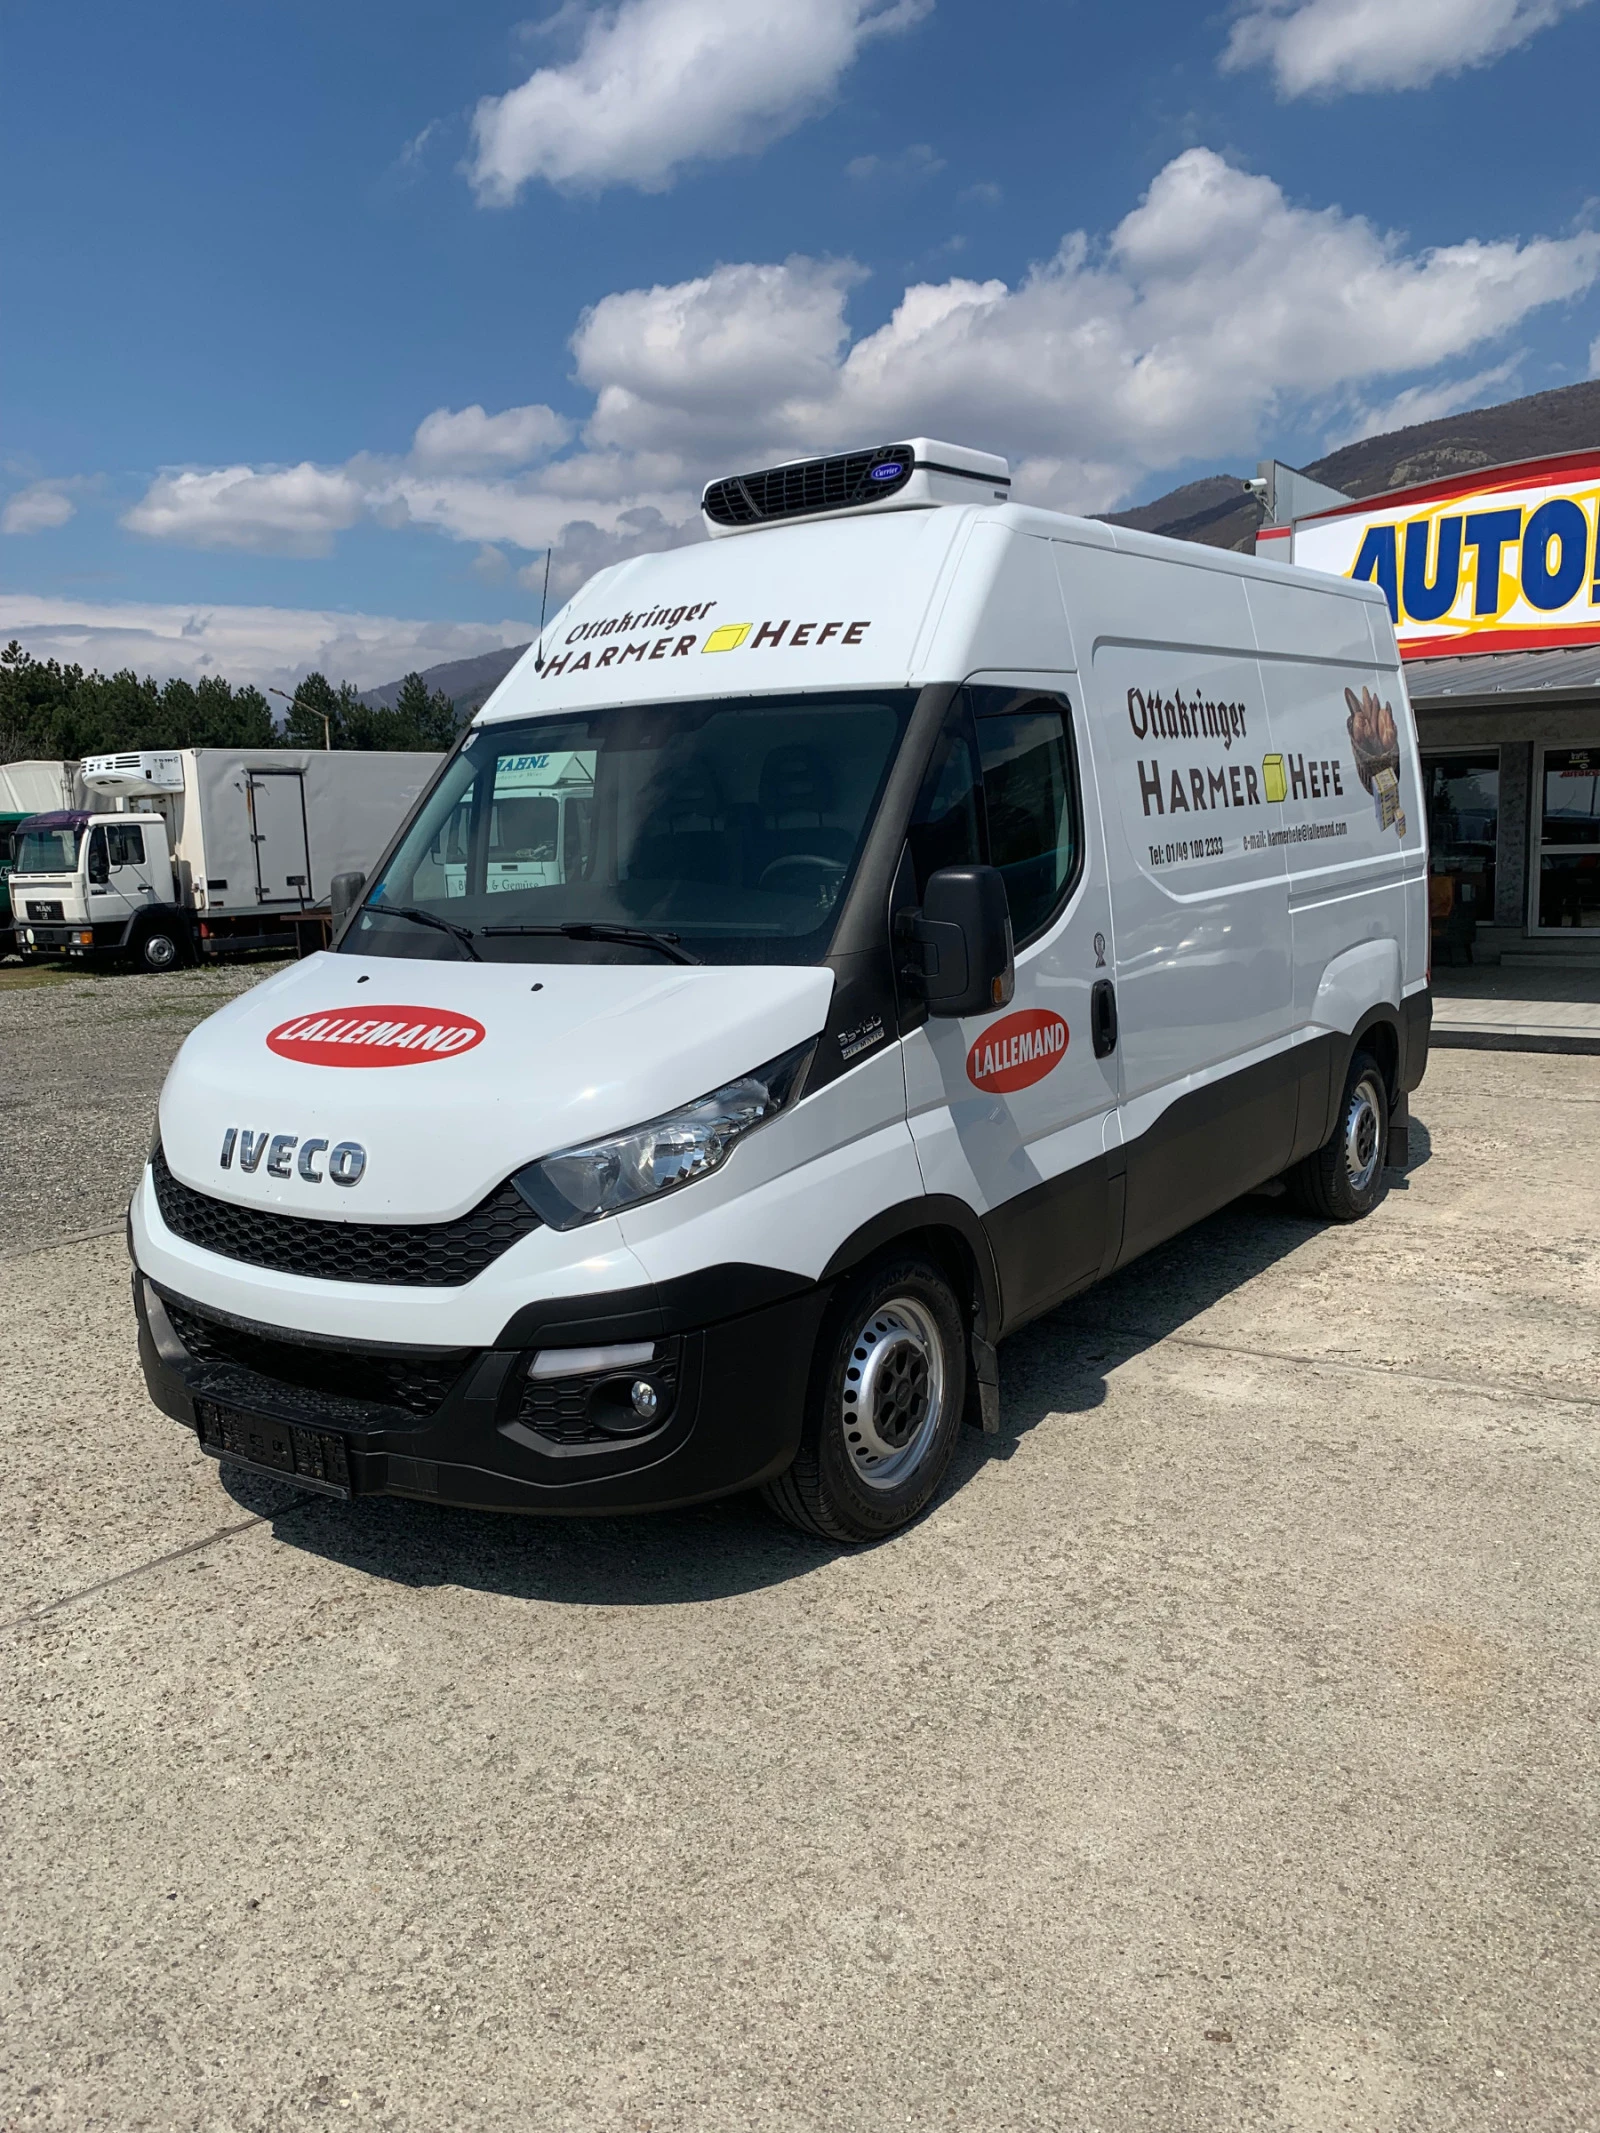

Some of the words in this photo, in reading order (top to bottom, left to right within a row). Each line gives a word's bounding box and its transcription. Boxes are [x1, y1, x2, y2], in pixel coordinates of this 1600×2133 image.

[874, 465, 898, 477] Carrier
[1351, 498, 1600, 624] AUTO
[541, 635, 697, 679] HARMER
[751, 620, 871, 649] HEFE
[565, 601, 717, 645] Ottakringer
[1127, 687, 1247, 751] Ottakringer
[1137, 760, 1261, 816] HARMER
[1287, 753, 1344, 800] HEFE
[1148, 845, 1165, 865] Tel:
[1165, 841, 1188, 863] 01/49
[1190, 839, 1204, 859] 100
[1205, 836, 1224, 856] 2333
[275, 1018, 477, 1052] LALLEMAND
[974, 1022, 1065, 1079] LALLEMAND
[220, 1128, 367, 1188] IVECO
